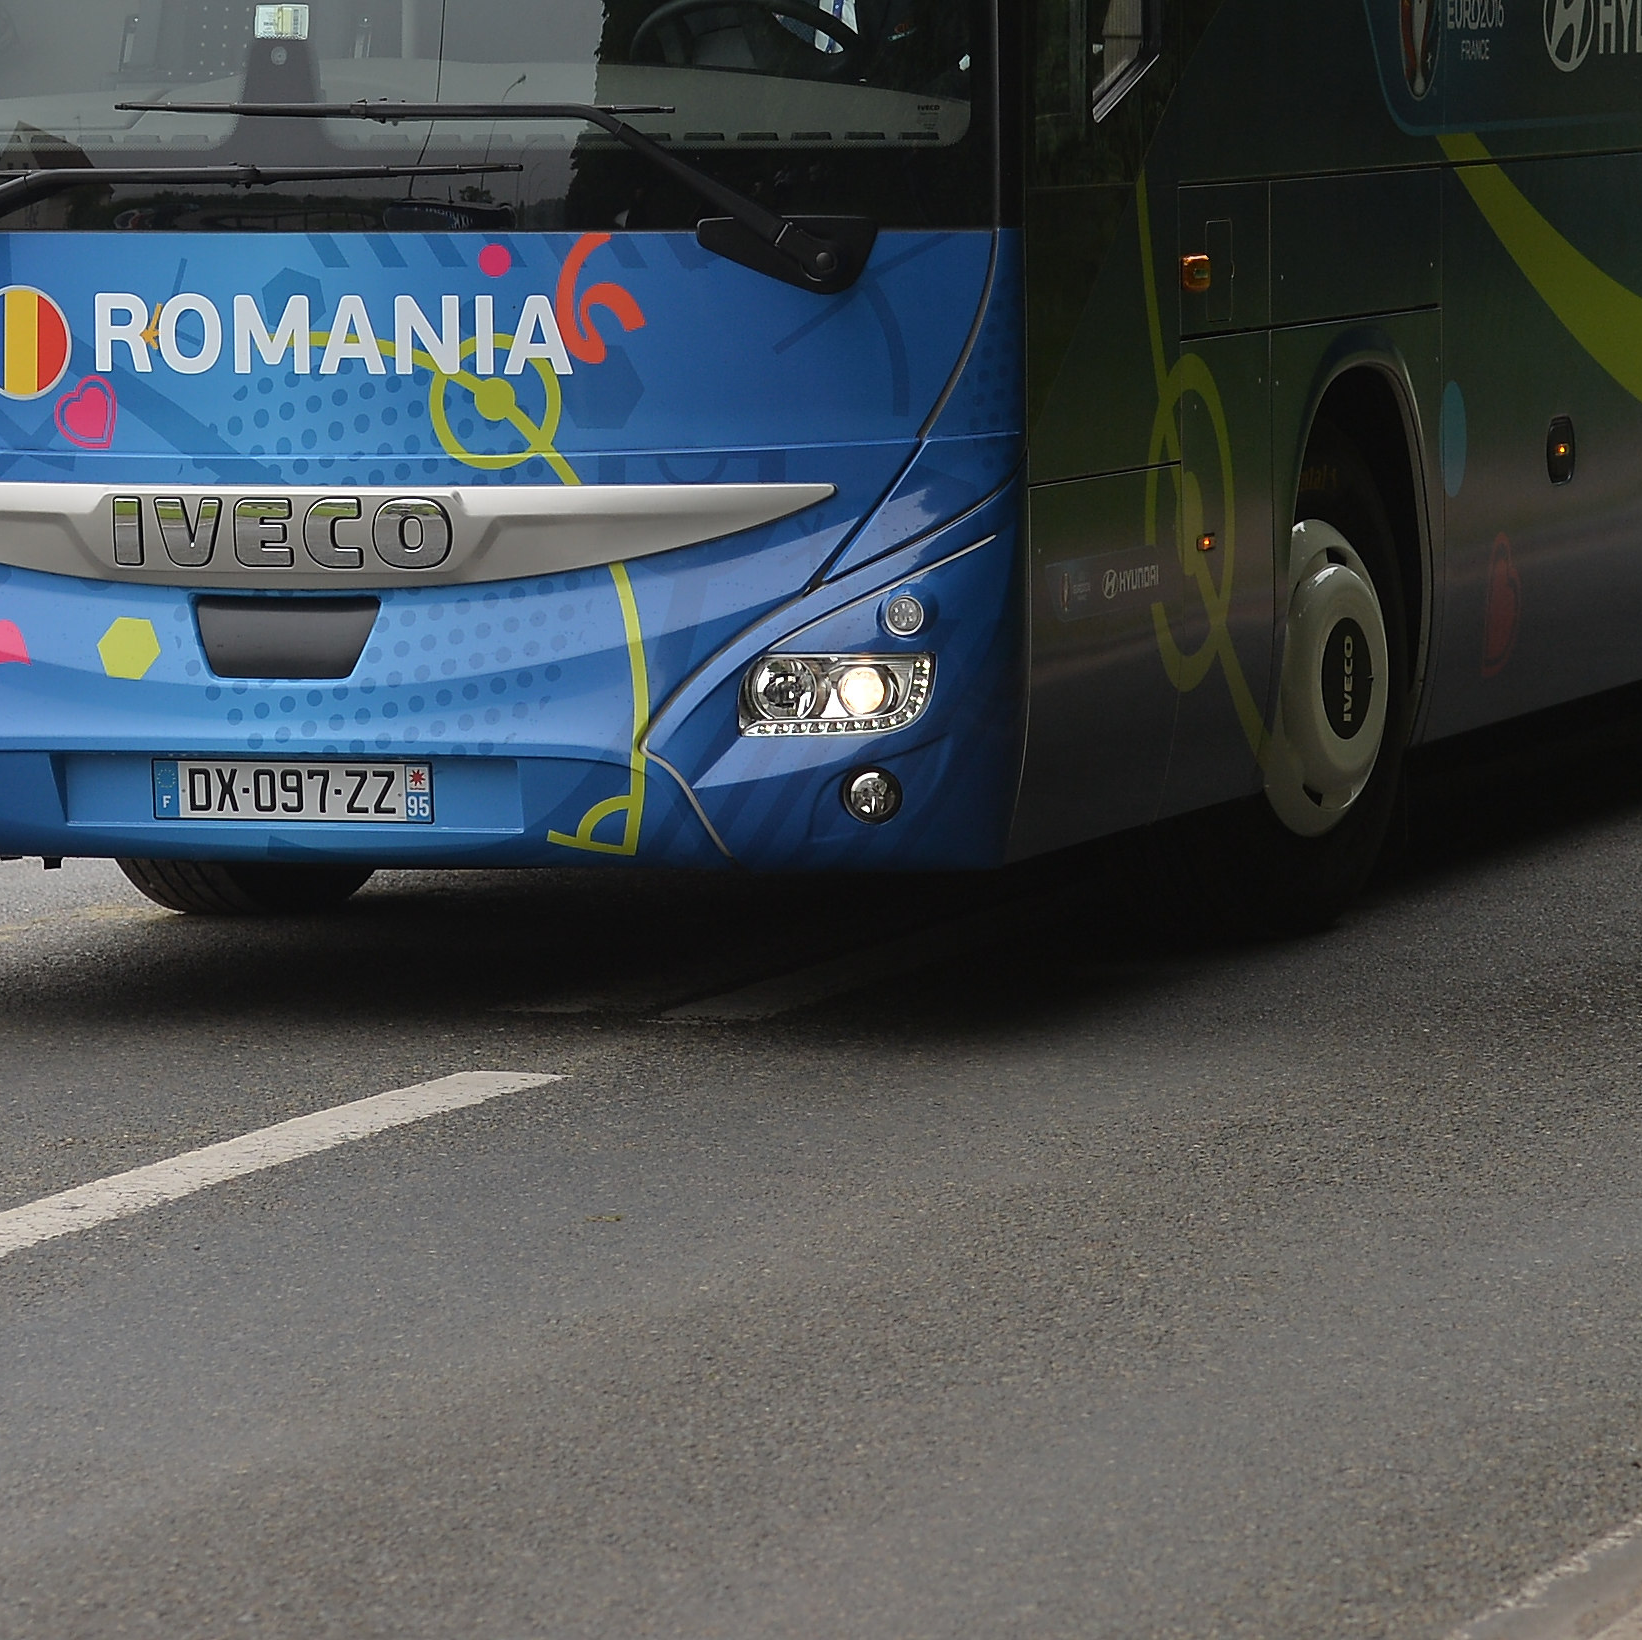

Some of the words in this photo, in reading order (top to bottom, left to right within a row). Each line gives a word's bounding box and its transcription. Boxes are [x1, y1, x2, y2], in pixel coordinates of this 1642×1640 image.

[1460, 39, 1490, 60] FRANCE
[93, 292, 574, 375] ROMANIA
[113, 495, 454, 570] IVECO
[1119, 564, 1159, 592] HYUNDAI
[1343, 635, 1353, 722] IVECO
[162, 795, 172, 809] F
[188, 768, 397, 814] DX-097-ZZ
[407, 796, 430, 818] 95
